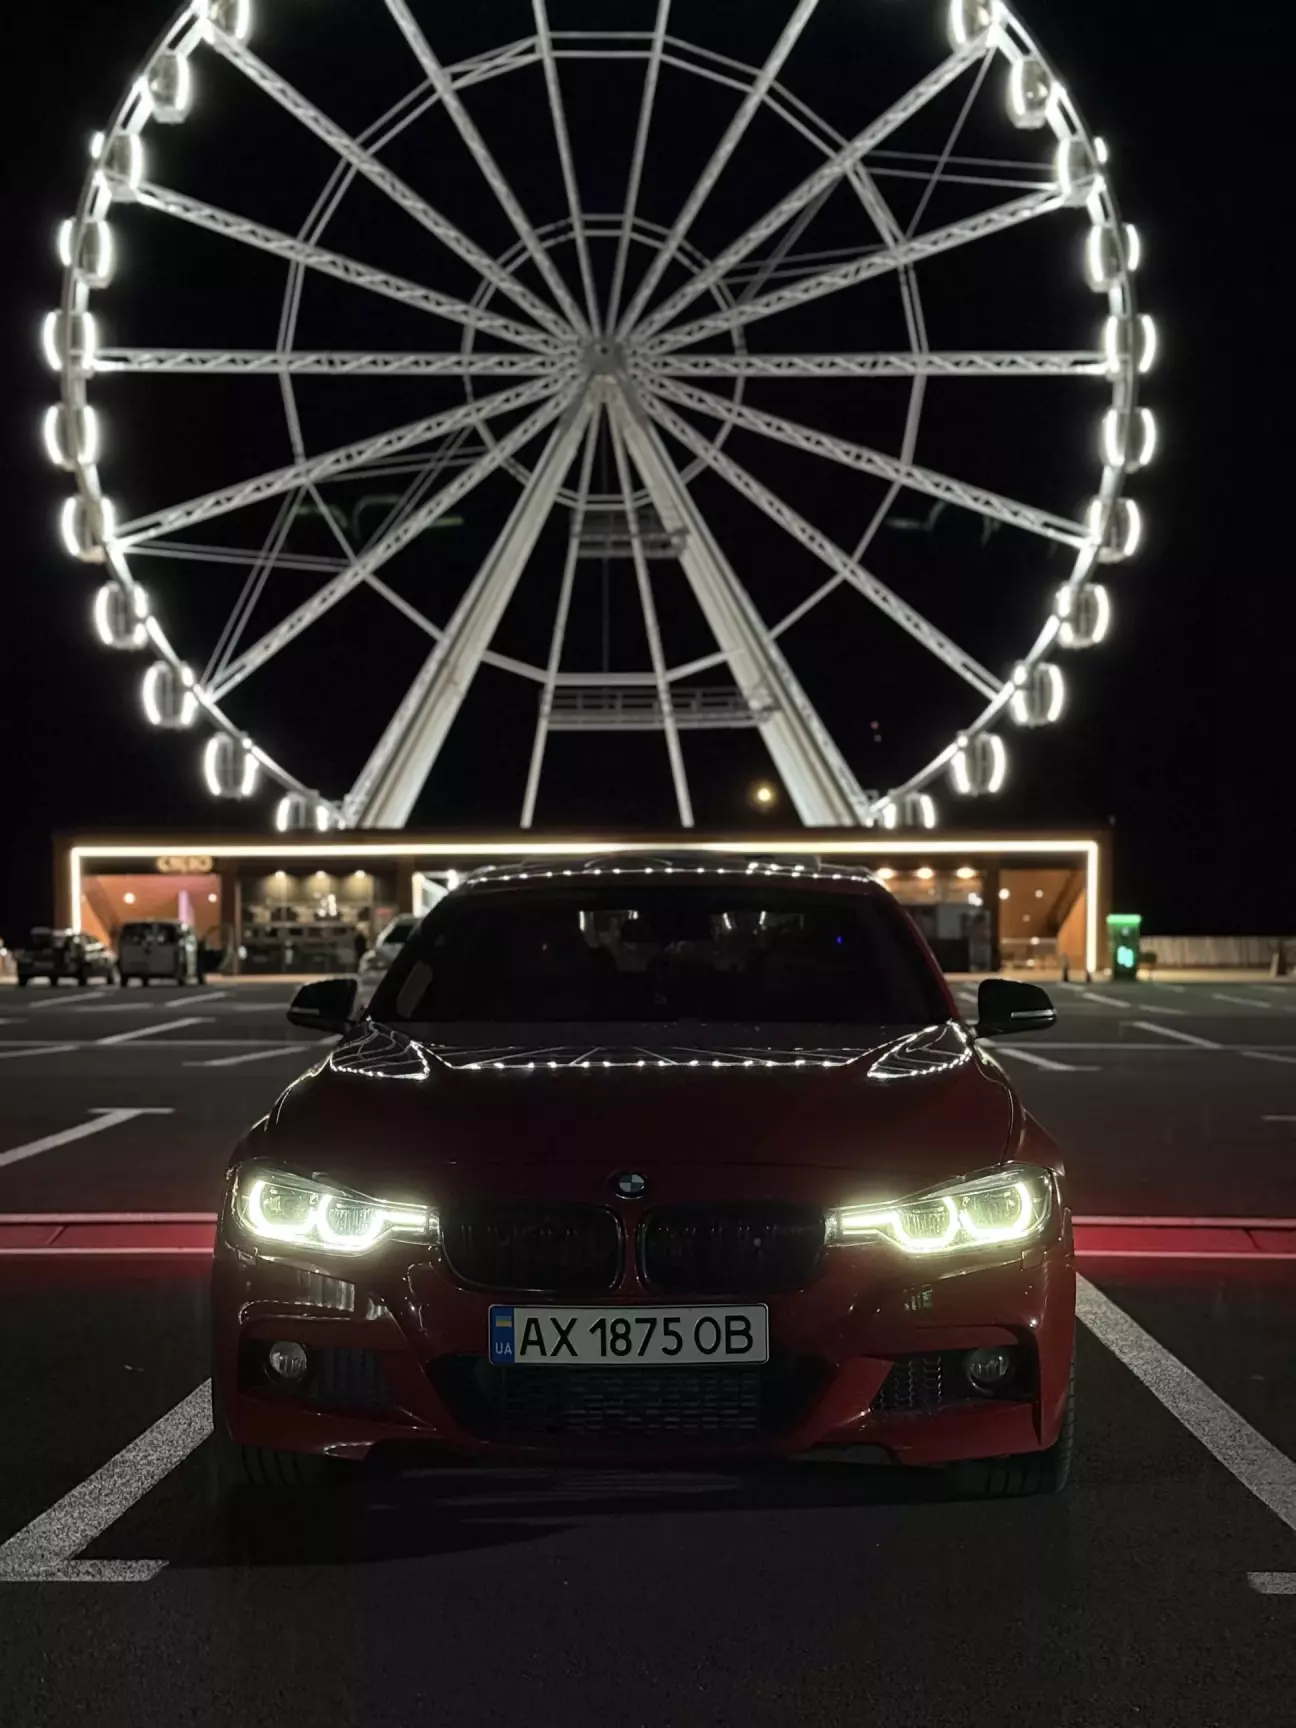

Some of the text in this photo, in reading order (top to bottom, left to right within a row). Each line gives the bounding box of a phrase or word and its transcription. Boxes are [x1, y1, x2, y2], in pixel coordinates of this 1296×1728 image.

[495, 1342, 512, 1355] UA
[519, 1315, 754, 1357] AX 1875 OB
